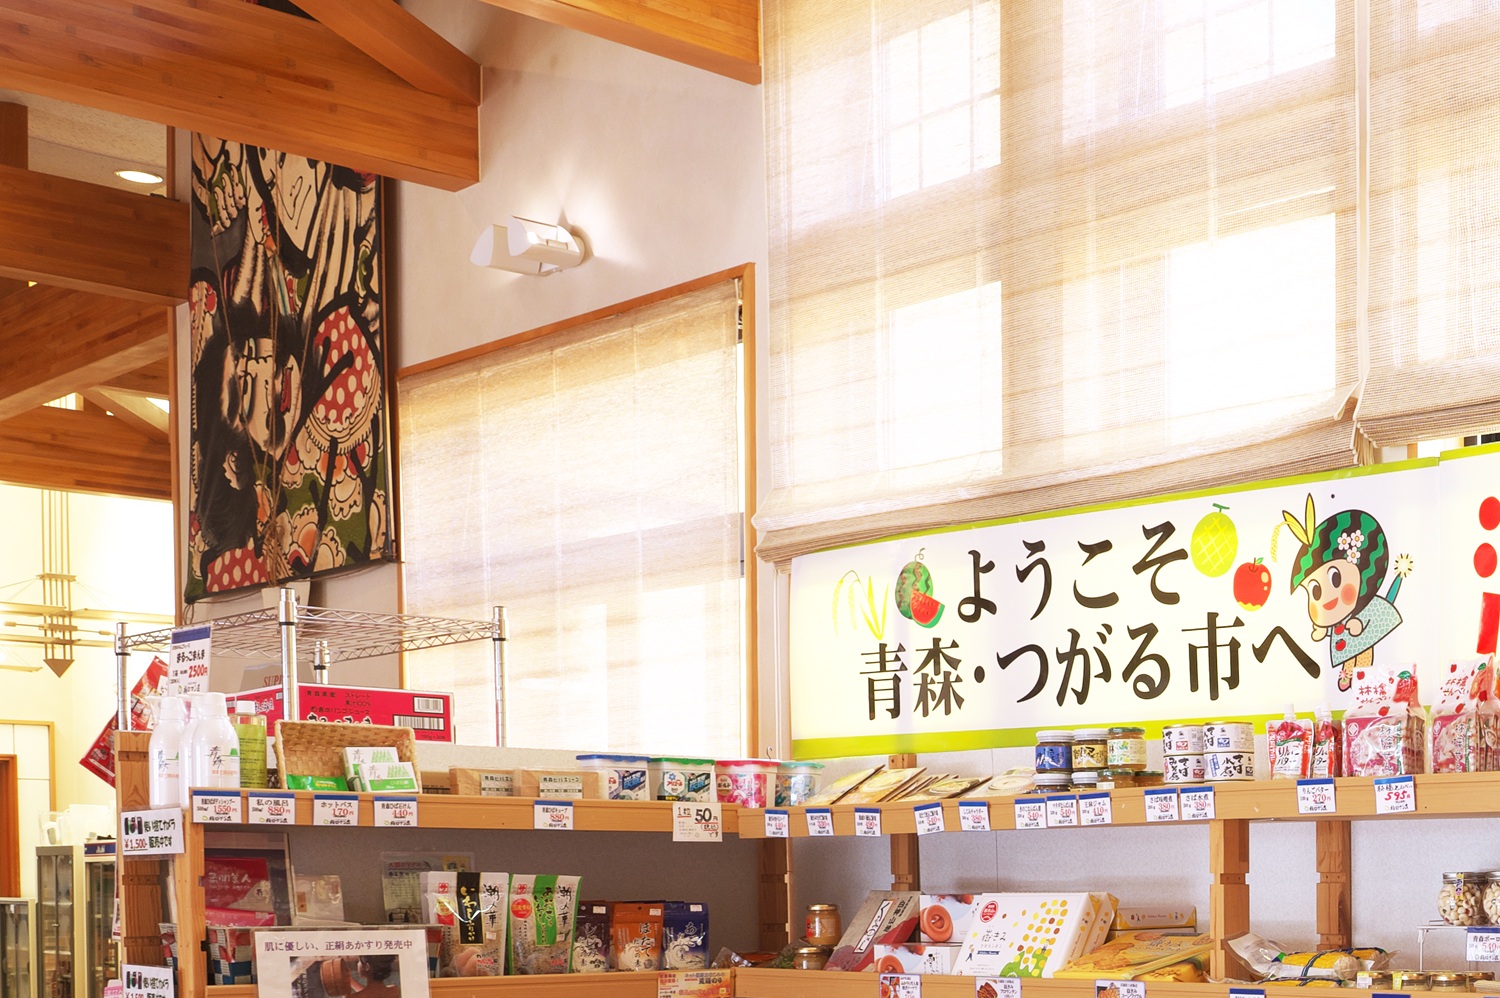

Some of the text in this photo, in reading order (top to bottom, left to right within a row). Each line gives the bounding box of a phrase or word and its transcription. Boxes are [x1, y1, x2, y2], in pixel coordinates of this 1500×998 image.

[958, 521, 1188, 624] ようこそ
[860, 611, 1321, 720] 青森・つがる市へ
[256, 798, 289, 807] 私の風呂
[213, 805, 237, 813] 1550円
[267, 806, 291, 815] 880円
[332, 808, 354, 816] 170円
[392, 809, 414, 818] 440円
[695, 807, 719, 822] 50円
